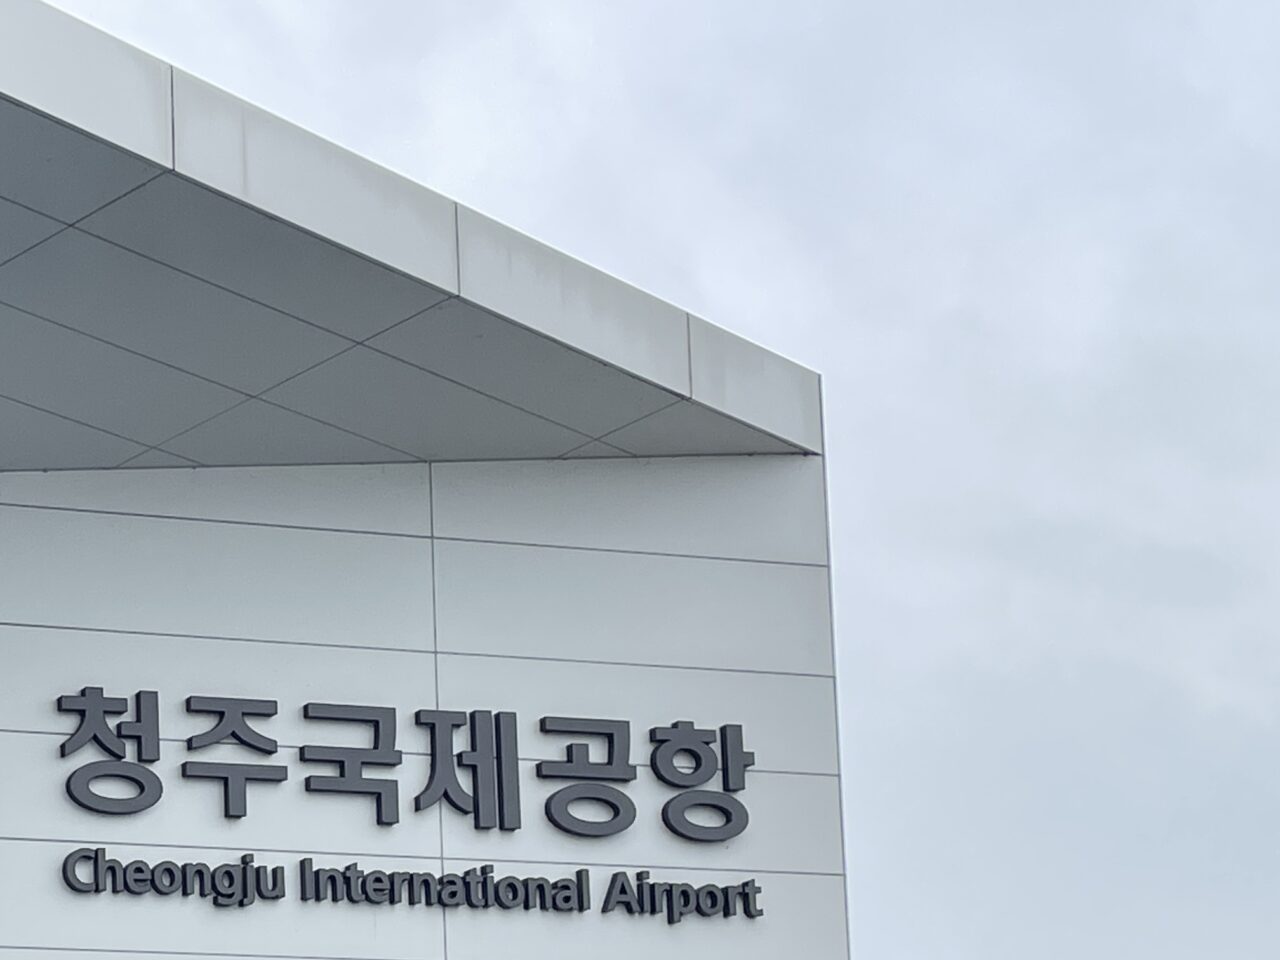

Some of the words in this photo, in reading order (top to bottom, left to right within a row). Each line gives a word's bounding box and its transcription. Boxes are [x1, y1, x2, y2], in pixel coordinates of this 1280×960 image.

[57, 686, 756, 842] 청주국제공항
[62, 847, 286, 908] Cheongju
[299, 857, 592, 914] International
[601, 870, 764, 924] Airport
